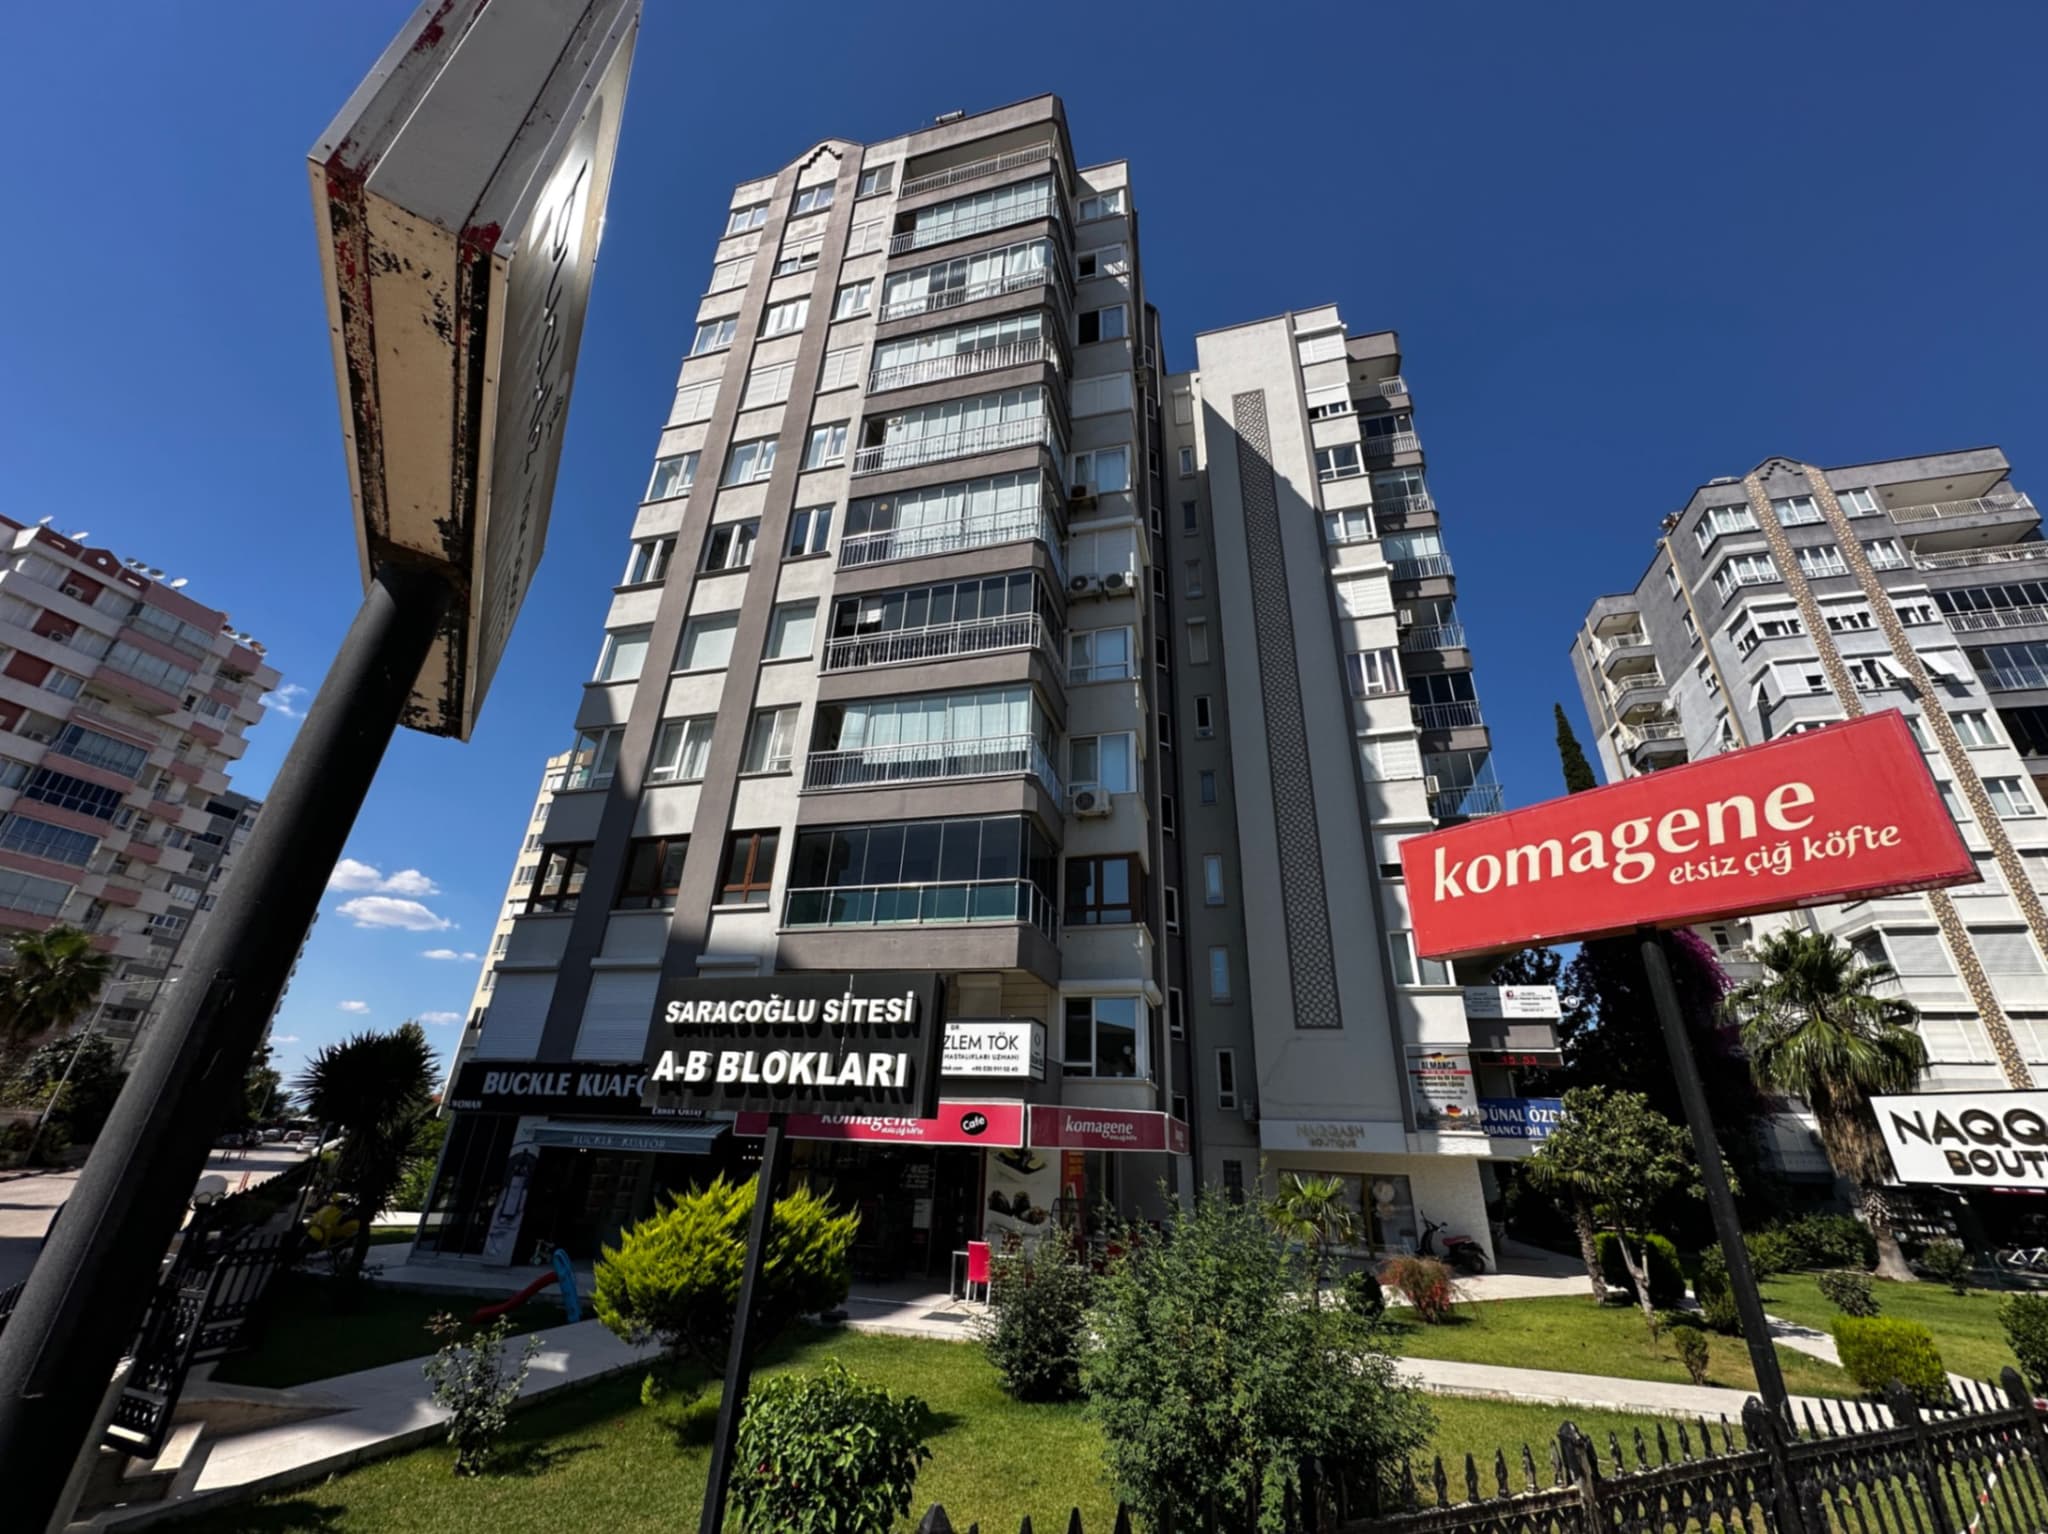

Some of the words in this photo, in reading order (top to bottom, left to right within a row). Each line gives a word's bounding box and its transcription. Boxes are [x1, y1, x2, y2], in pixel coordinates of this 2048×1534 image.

[1433, 781, 1816, 901] komagene
[1668, 856, 1740, 886] etsiz
[1744, 840, 1793, 876] çiğ
[1803, 825, 1902, 863] köfte
[665, 993, 816, 1024] SARACOĞLU
[822, 990, 914, 1024] SİTESİ
[943, 1034, 982, 1050] ZLEM
[987, 1031, 1019, 1050] TÖK
[651, 1050, 708, 1082] A-B
[716, 1050, 908, 1087] BLOKLARI
[482, 1072, 571, 1096] BUCKLE
[576, 1071, 648, 1097] KUAF
[962, 1115, 985, 1131] Cafe
[1489, 1105, 1525, 1122] ÜNAL
[1065, 1115, 1134, 1139] komagene
[1482, 1125, 1522, 1136] ABANCI
[1943, 1149, 2048, 1179] BOUT
